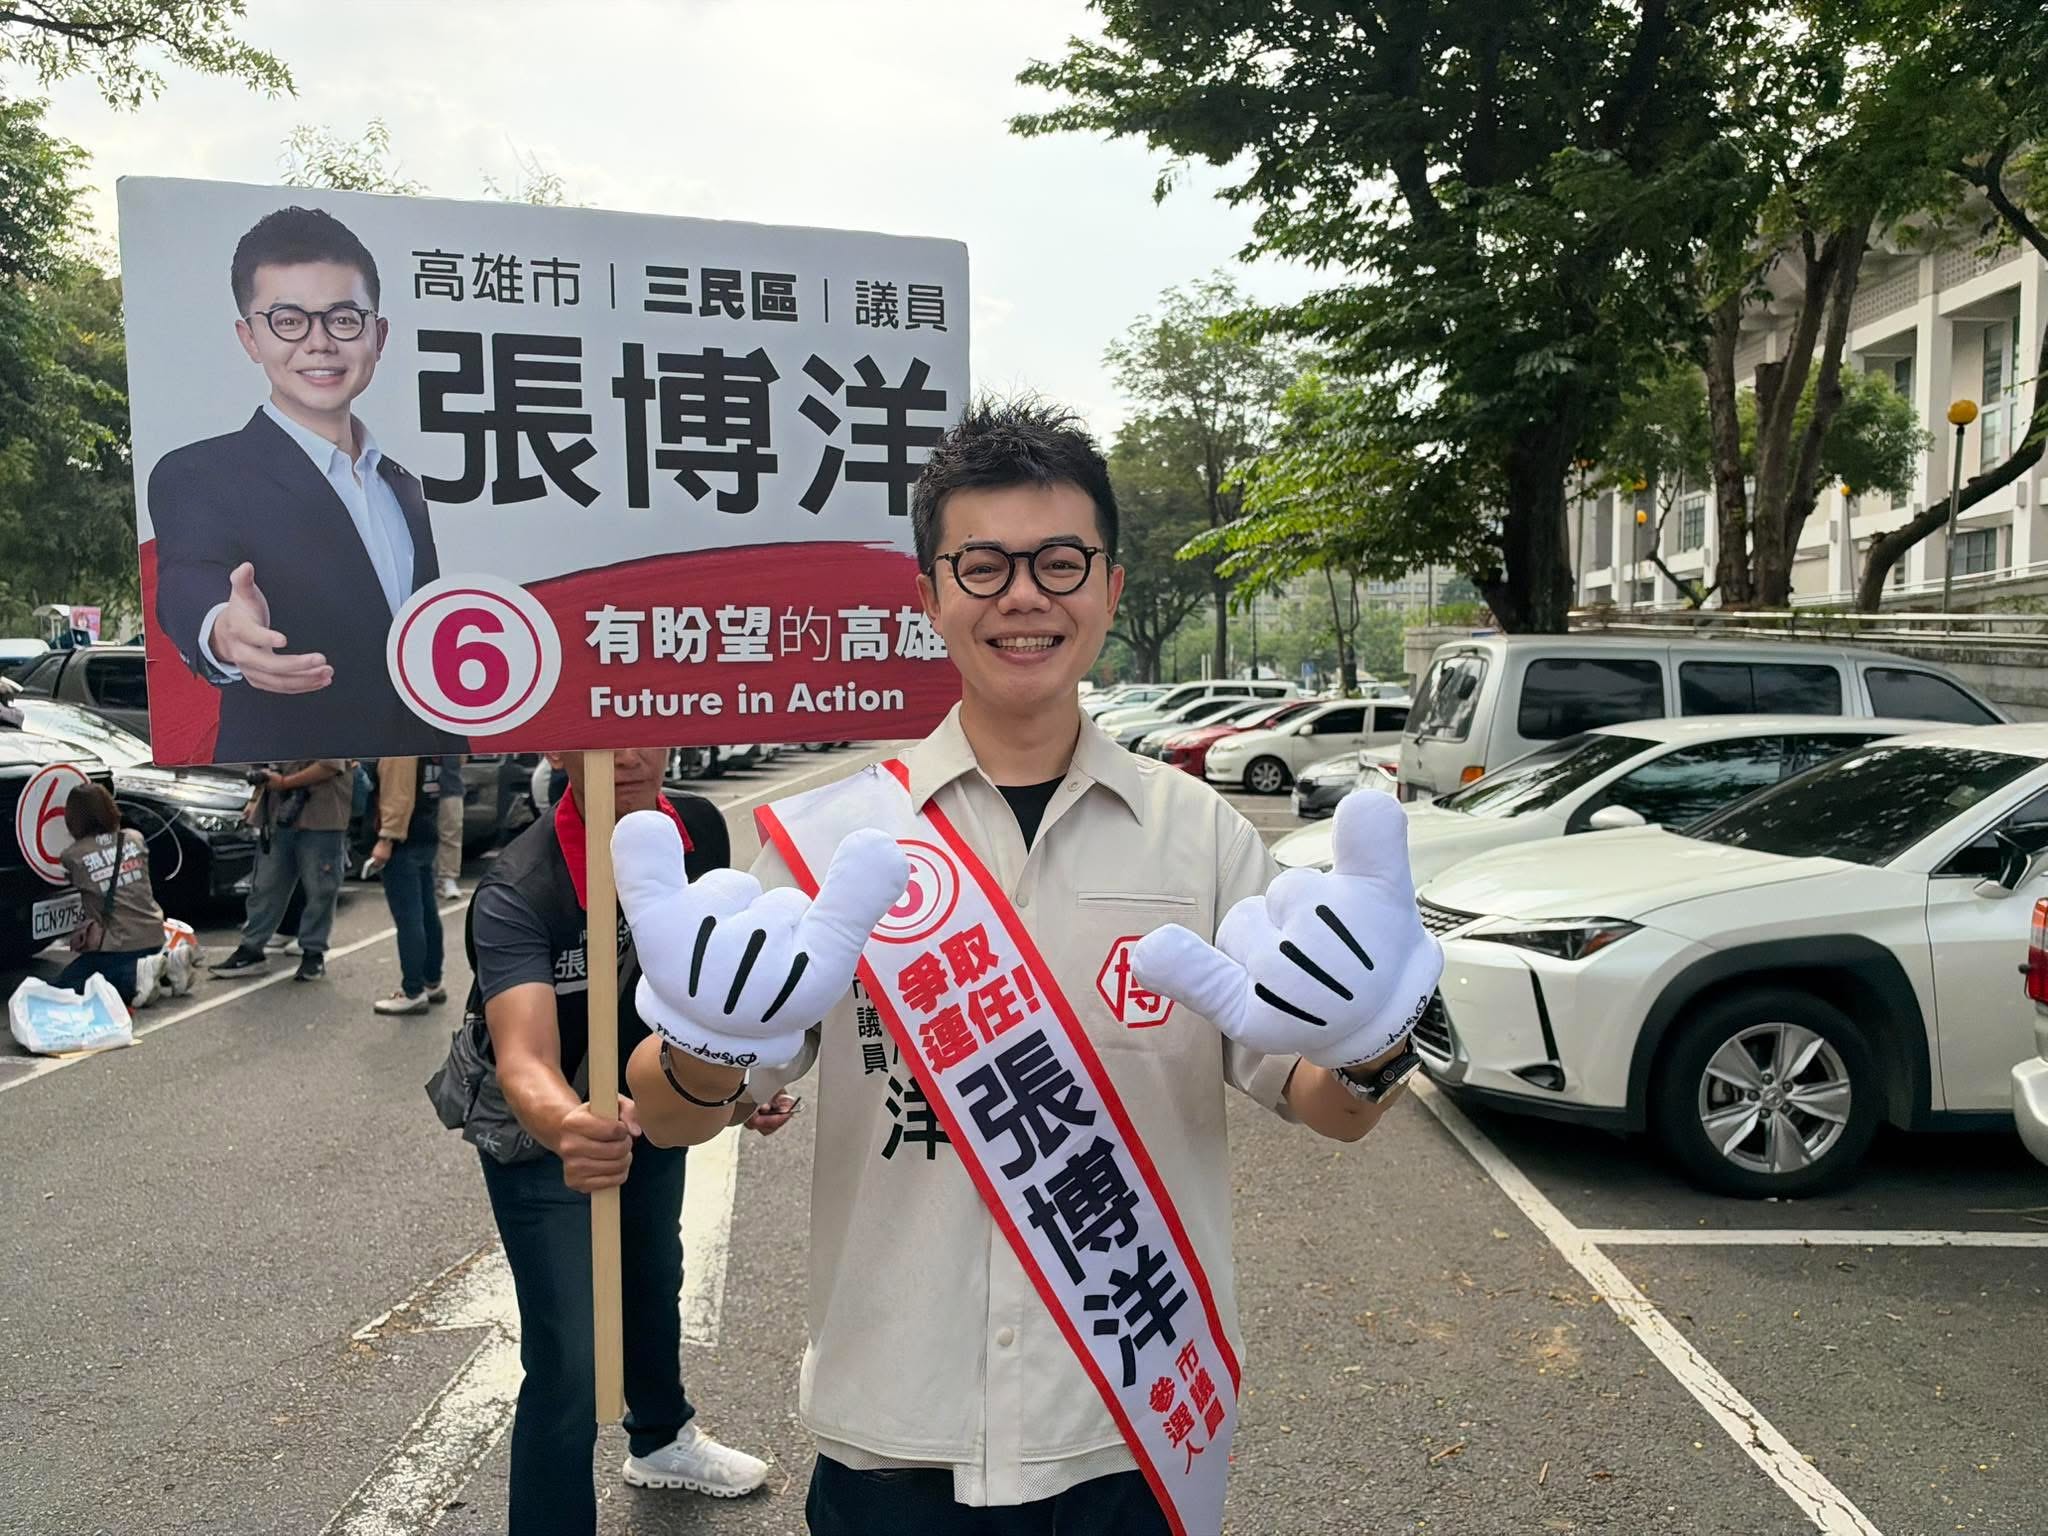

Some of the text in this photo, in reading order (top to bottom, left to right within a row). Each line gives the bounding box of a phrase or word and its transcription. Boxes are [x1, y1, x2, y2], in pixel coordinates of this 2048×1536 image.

[412, 248, 948, 332] 高雄市 三民區 議員
[417, 329, 947, 517] 張博洋
[432, 608, 510, 708] 6
[585, 604, 949, 665] 有盼望的高雄
[590, 681, 905, 718] Future in Action
[898, 922, 1000, 1015] 爭取
[955, 1028, 1189, 1388] 張博洋
